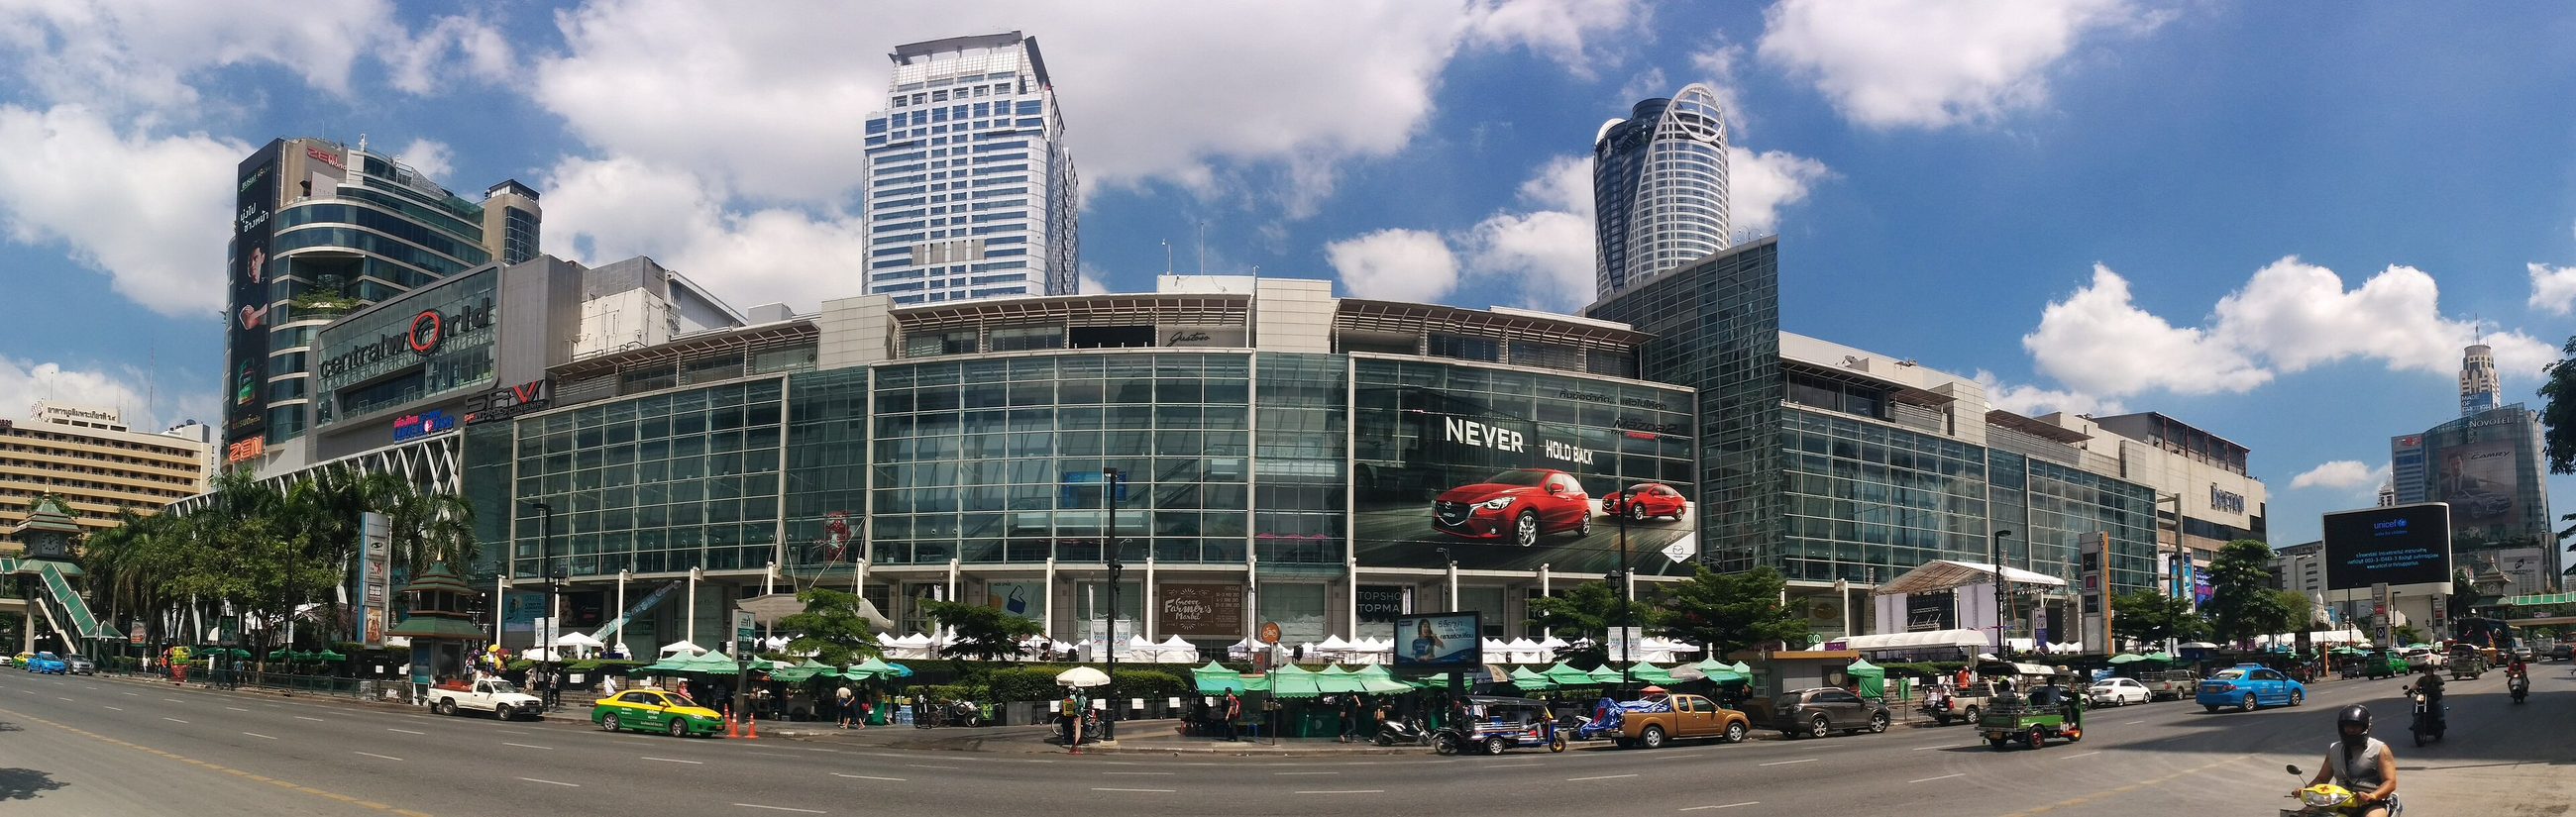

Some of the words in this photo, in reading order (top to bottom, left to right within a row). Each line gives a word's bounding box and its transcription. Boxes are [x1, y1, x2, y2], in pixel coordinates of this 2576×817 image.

[307, 146, 338, 164] ZEN
[2469, 417, 2512, 427] NOVOTEL
[1446, 416, 1524, 454] NEVER
[230, 436, 264, 462] ZEN
[1546, 439, 1571, 461] HOLD
[1573, 446, 1594, 465] BACK
[2471, 451, 2511, 460] CAMRY
[2374, 519, 2397, 530] unicef
[1164, 599, 1212, 613] Farmer's
